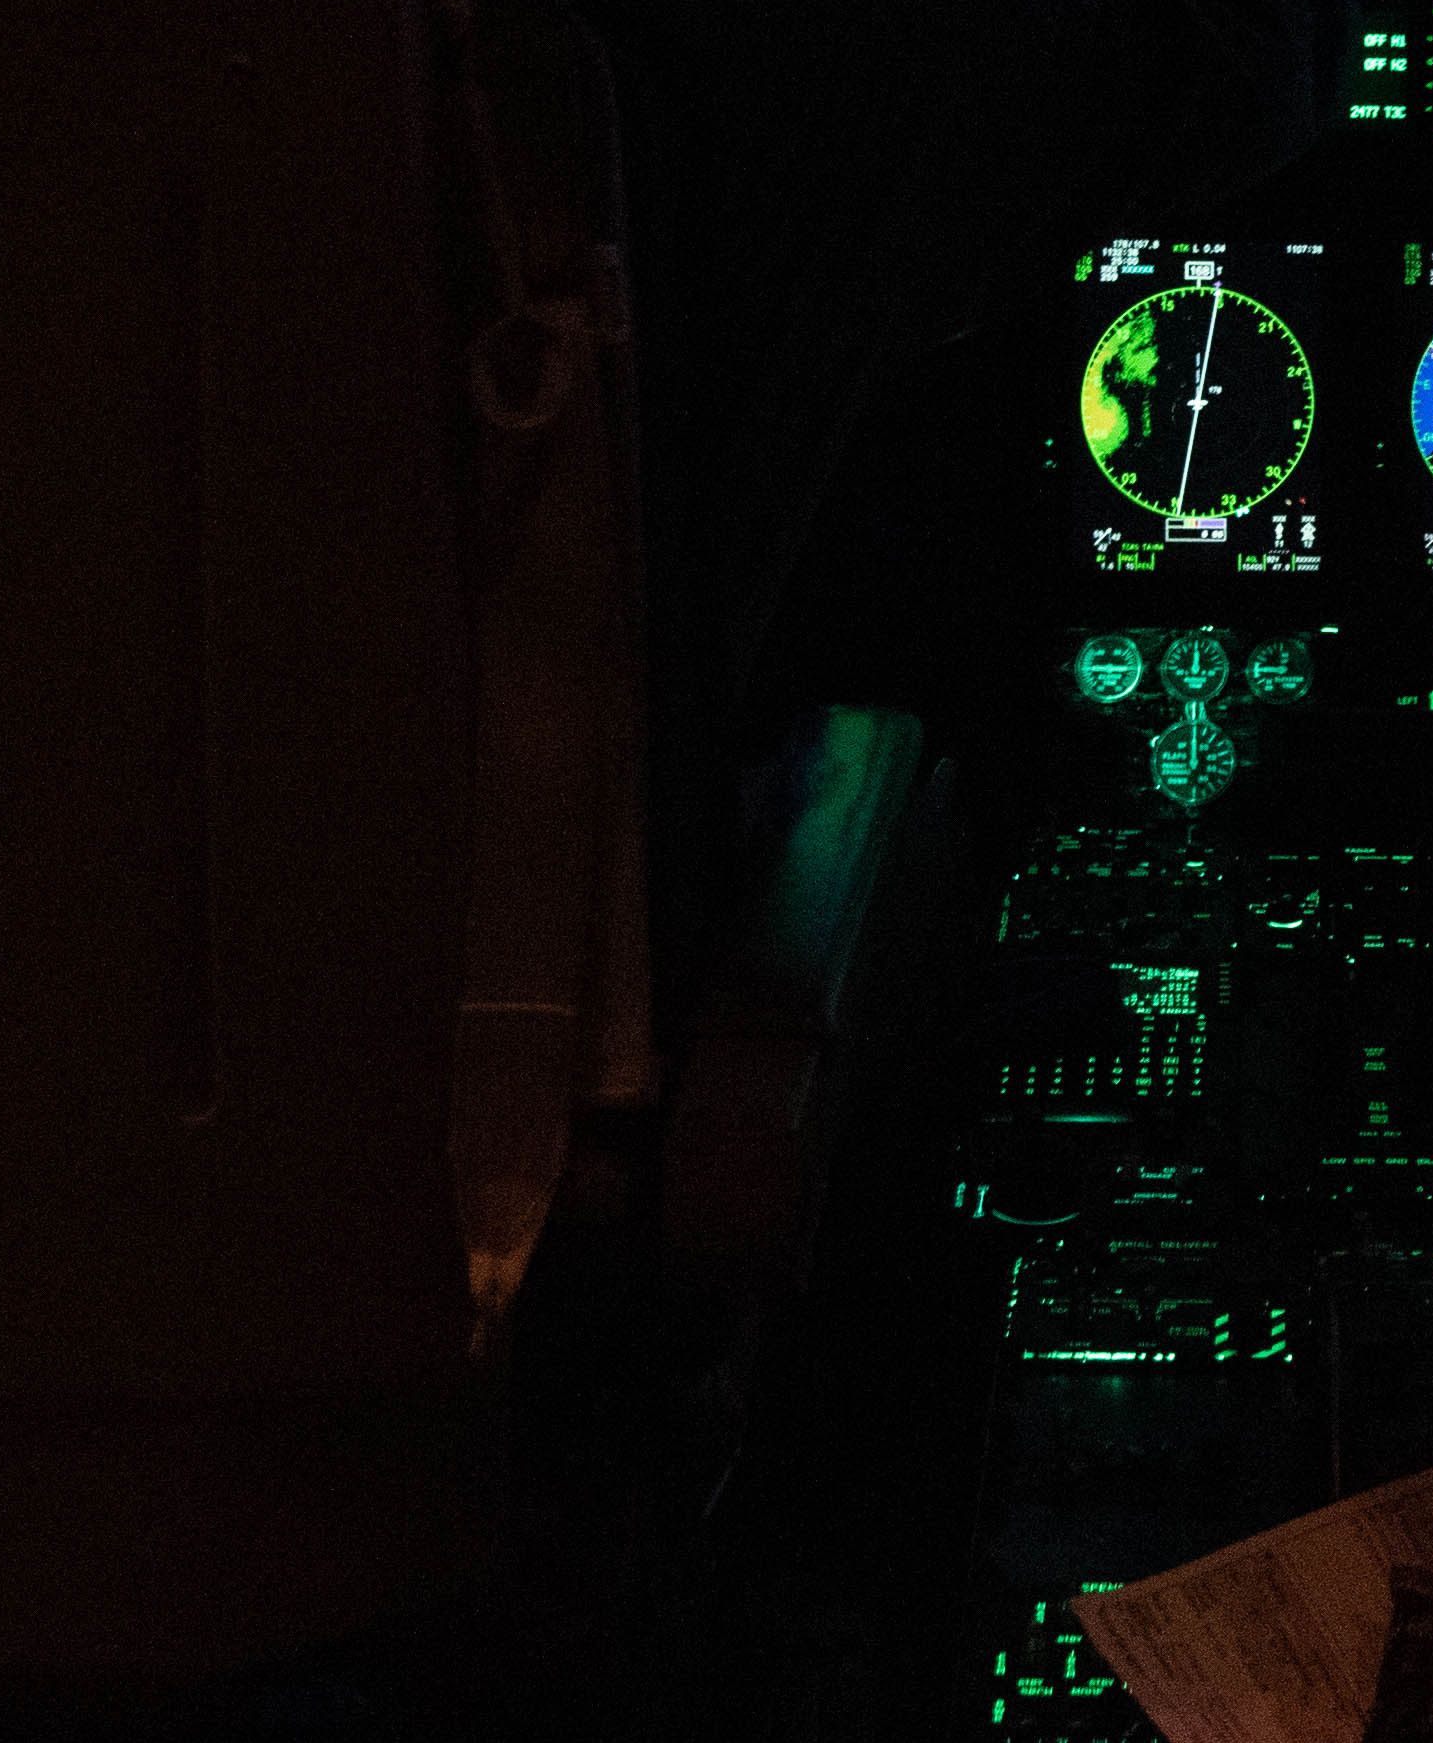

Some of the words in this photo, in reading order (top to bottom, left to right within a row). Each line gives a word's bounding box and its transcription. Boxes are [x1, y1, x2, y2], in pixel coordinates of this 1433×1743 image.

[1364, 34, 1387, 47] OFF
[1364, 58, 1387, 71] OFF
[1287, 366, 1302, 378] 24
[1265, 465, 1281, 477] 30
[1121, 473, 1137, 484] 03
[1221, 494, 1237, 506] 33
[1396, 696, 1419, 705] LEFT
[1321, 1157, 1347, 1165] LOW
[1384, 1157, 1409, 1165] GND
